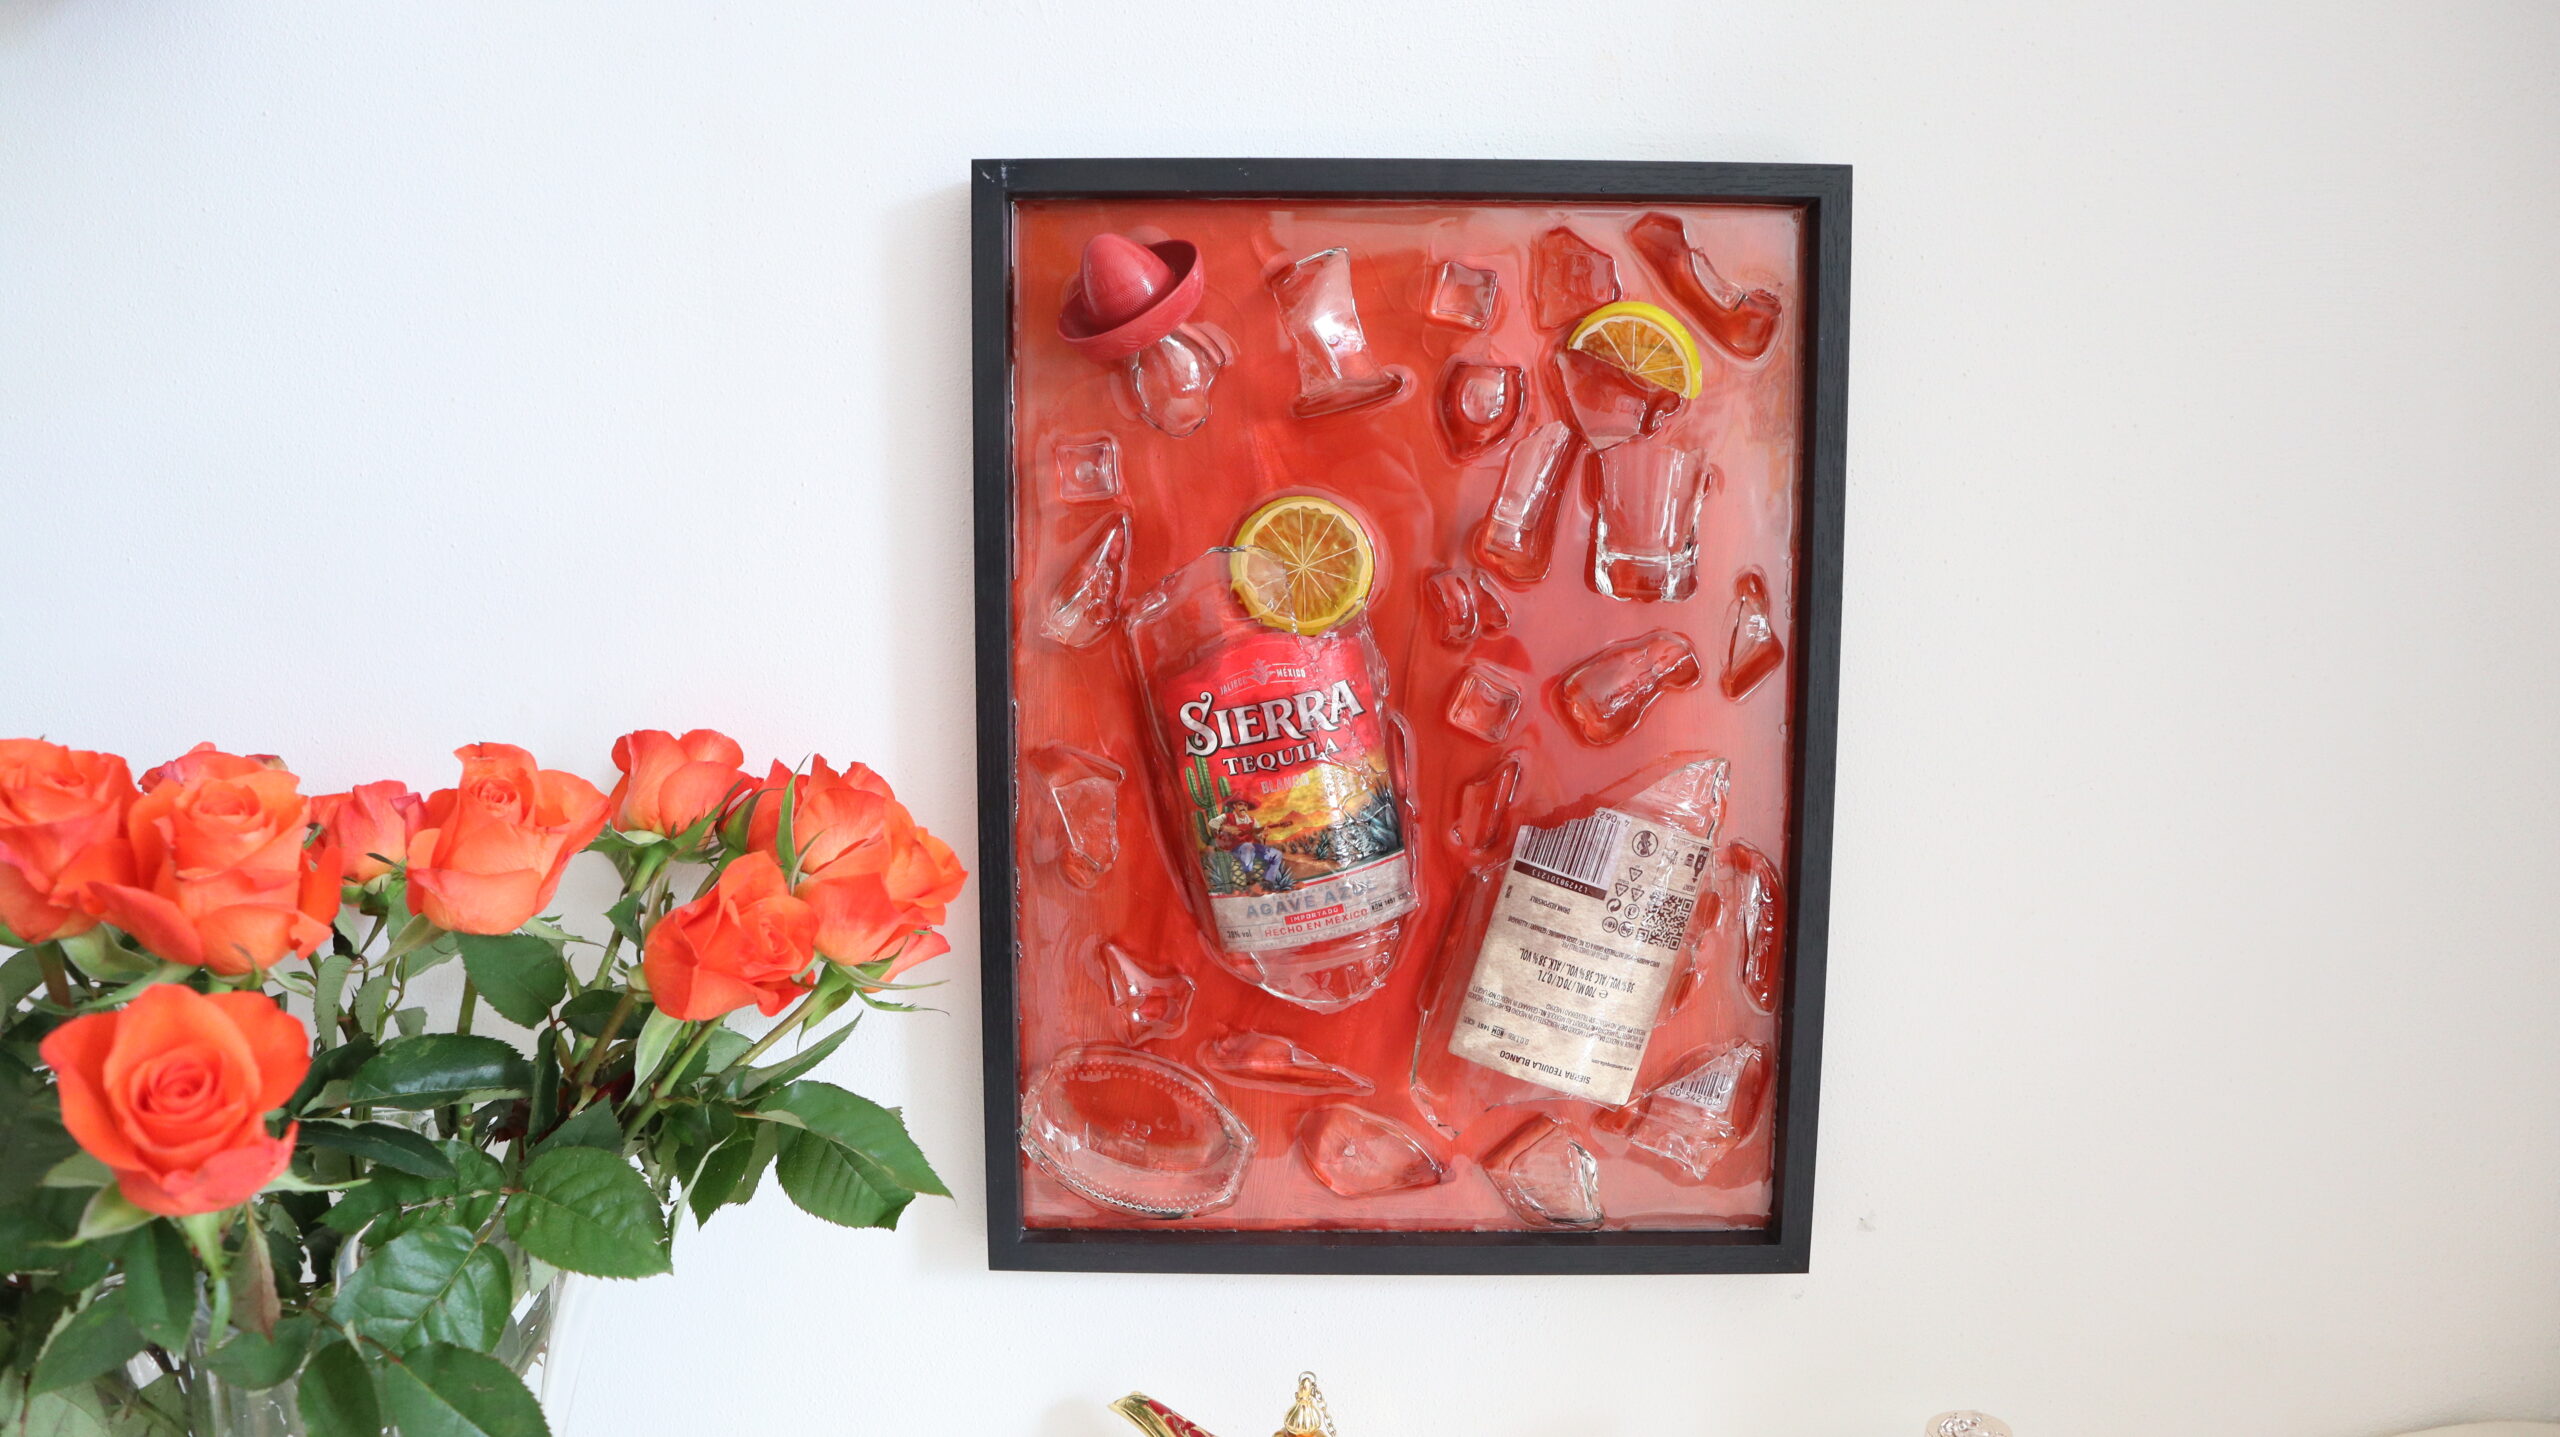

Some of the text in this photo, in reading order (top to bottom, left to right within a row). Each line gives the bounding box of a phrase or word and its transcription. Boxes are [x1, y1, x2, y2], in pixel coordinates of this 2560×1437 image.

[1276, 666, 1306, 679] MÉXICO
[1179, 680, 1367, 757] SIERRA
[1222, 737, 1341, 776] TEQUILA
[1260, 774, 1310, 794] BLANCO
[1595, 810, 1618, 823] 062
[1247, 897, 1315, 919] AGAVE
[1289, 907, 1339, 922] IMPORTADO
[1264, 908, 1368, 937] HECHO EN MÉXICO
[1242, 929, 1253, 938] vol
[1516, 946, 1533, 962] VOL.
[1537, 953, 1548, 967] 38
[1545, 956, 1562, 972] ALK.
[1583, 968, 1594, 982] 38
[1562, 977, 1572, 990] 70
[1574, 981, 1586, 995] ML
[1583, 983, 1597, 998] 700
[1498, 1049, 1531, 1067] BLANCO
[1530, 1060, 1563, 1077] TEQUILA
